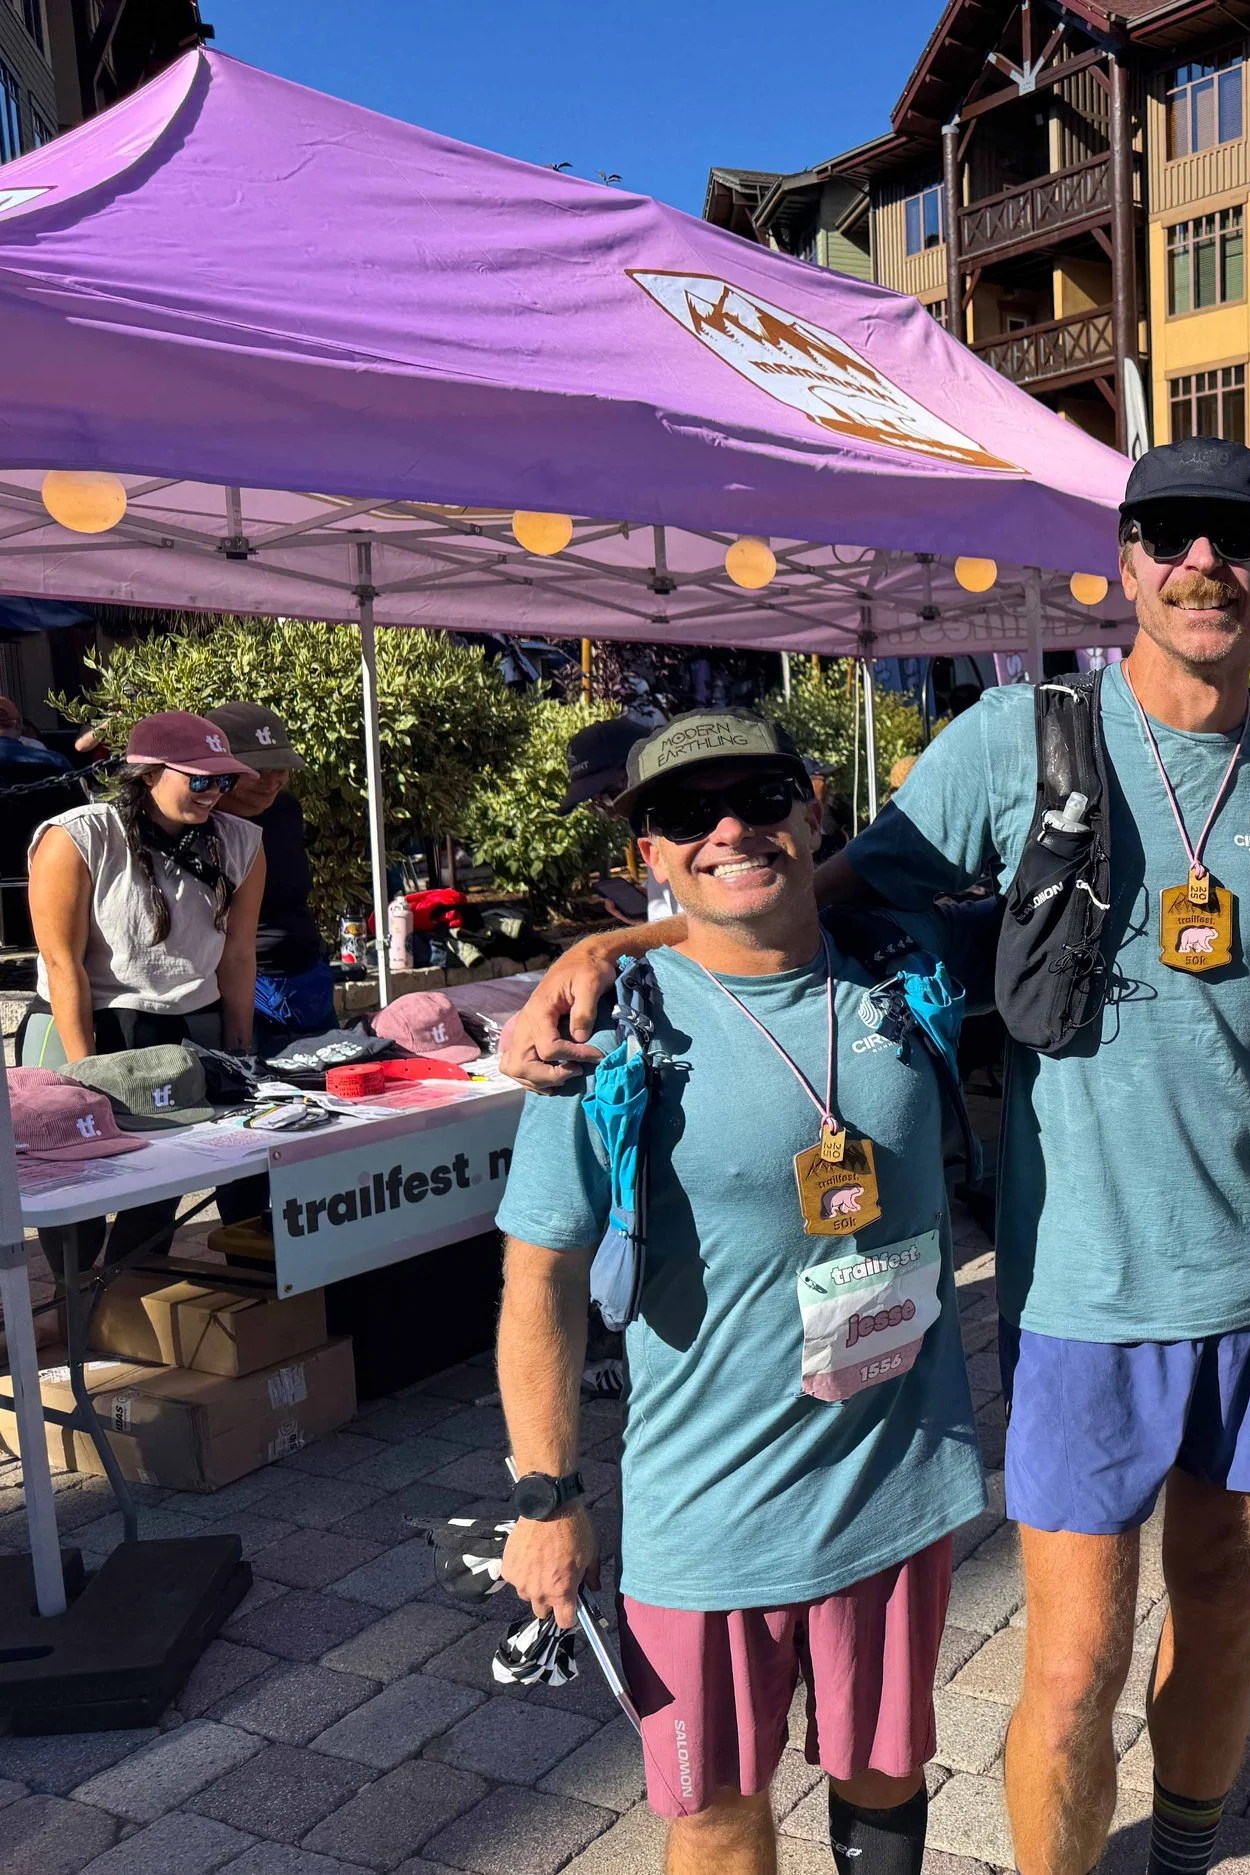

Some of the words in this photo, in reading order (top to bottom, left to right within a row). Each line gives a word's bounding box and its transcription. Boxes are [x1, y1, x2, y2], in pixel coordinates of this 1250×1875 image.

[658, 734, 748, 768] EARTHLING
[661, 722, 731, 752] MODERN
[1185, 955, 1208, 966] 50k
[833, 1217, 857, 1232] 50k
[846, 1299, 916, 1349] jesse
[859, 1355, 902, 1383] 1556
[674, 1719, 694, 1799] SALOMON
